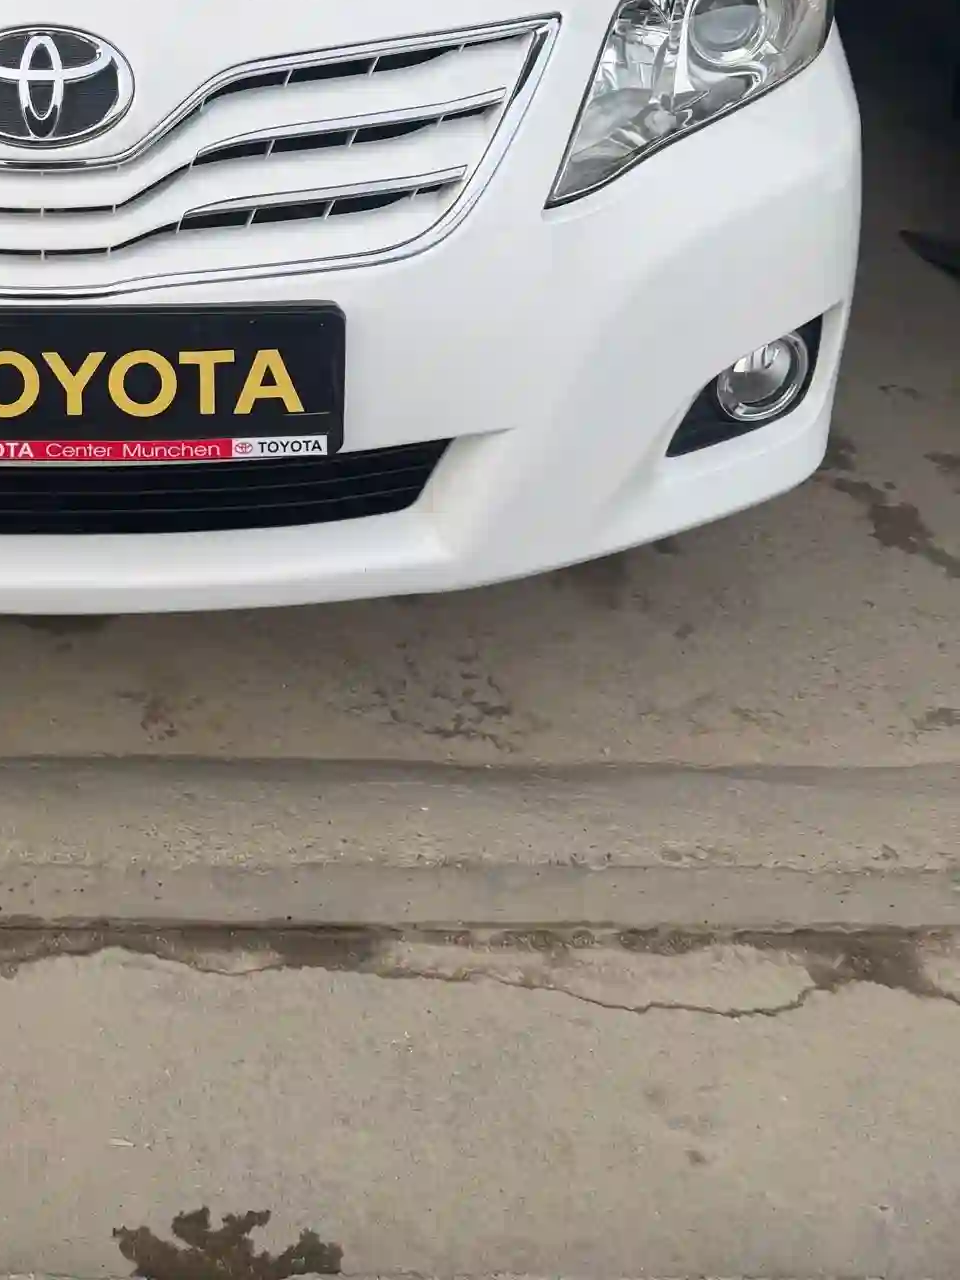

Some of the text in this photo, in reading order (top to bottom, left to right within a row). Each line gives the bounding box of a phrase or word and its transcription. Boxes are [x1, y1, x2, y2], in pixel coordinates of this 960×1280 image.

[45, 442, 114, 458] Center
[122, 442, 220, 458] Munchen
[258, 439, 323, 453] TOYOTA
